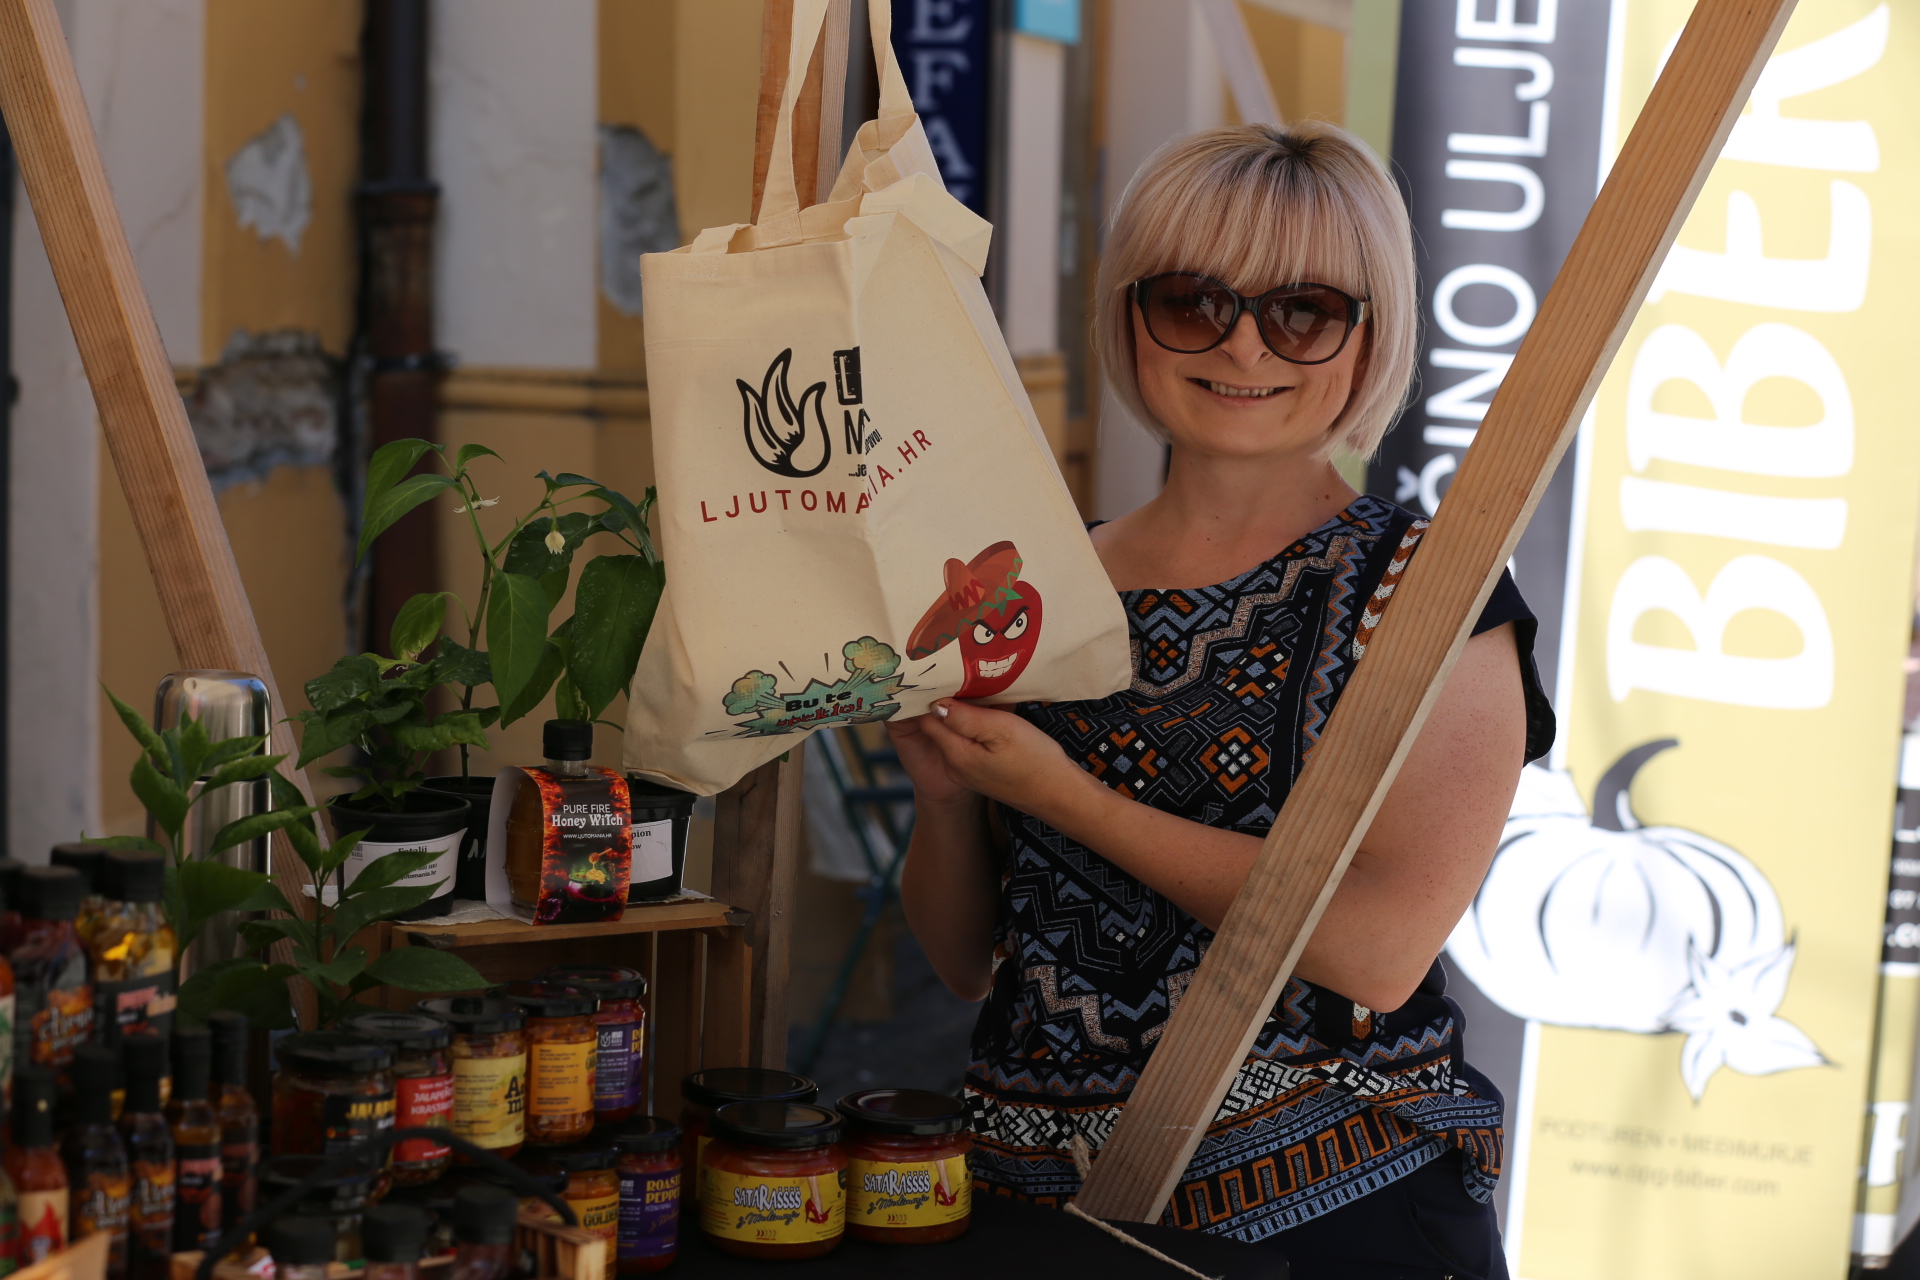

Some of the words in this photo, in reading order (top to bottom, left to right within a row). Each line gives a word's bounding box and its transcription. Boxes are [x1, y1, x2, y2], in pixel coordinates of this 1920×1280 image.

[1441, 0, 1558, 232] ULJE
[701, 430, 932, 522] LJUTOMAIA.HR
[551, 814, 586, 828] Honey
[563, 804, 588, 814] PURE
[591, 803, 611, 813] FIRE
